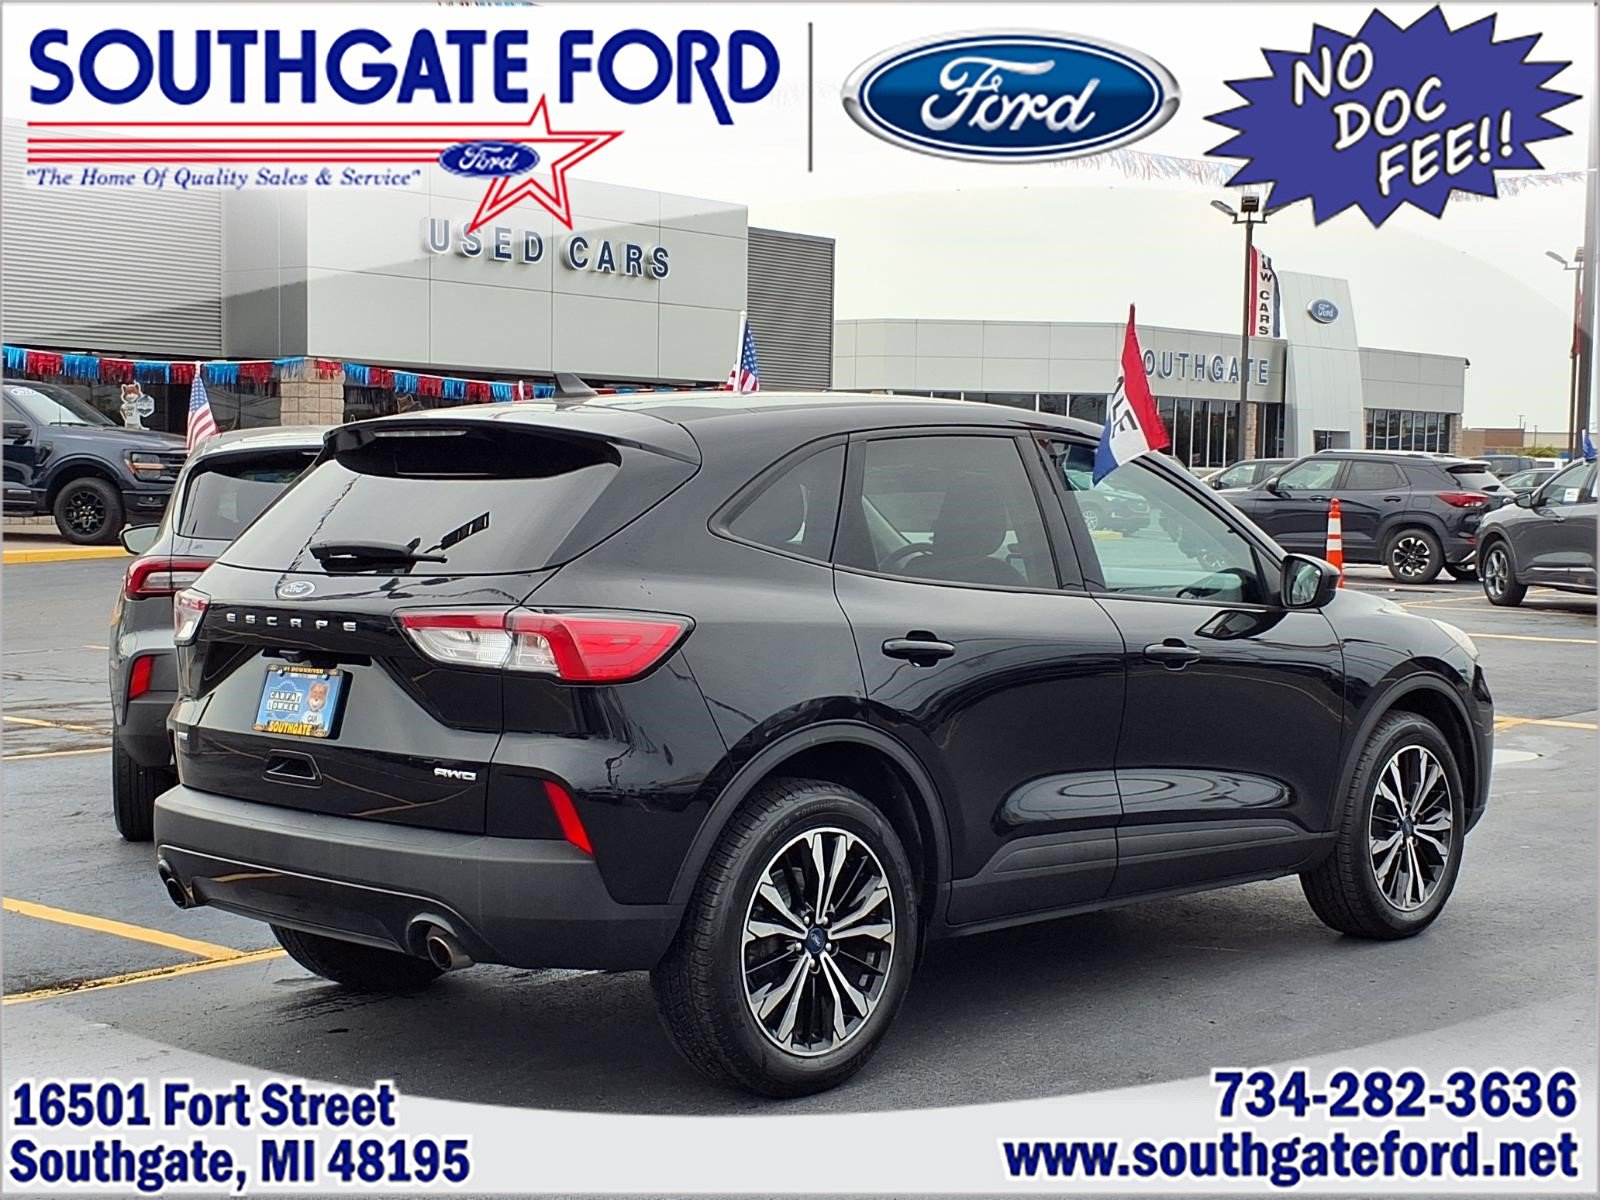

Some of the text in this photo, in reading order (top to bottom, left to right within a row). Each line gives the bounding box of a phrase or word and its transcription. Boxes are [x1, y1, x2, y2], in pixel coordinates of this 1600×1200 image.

[429, 217, 670, 280] USED CARS
[1259, 290, 1271, 335] CARS
[1143, 349, 1268, 384] OUTHGATE
[226, 612, 357, 632] ESCAPE
[268, 720, 312, 736] SOUTHGATE
[434, 767, 476, 780] AWD
